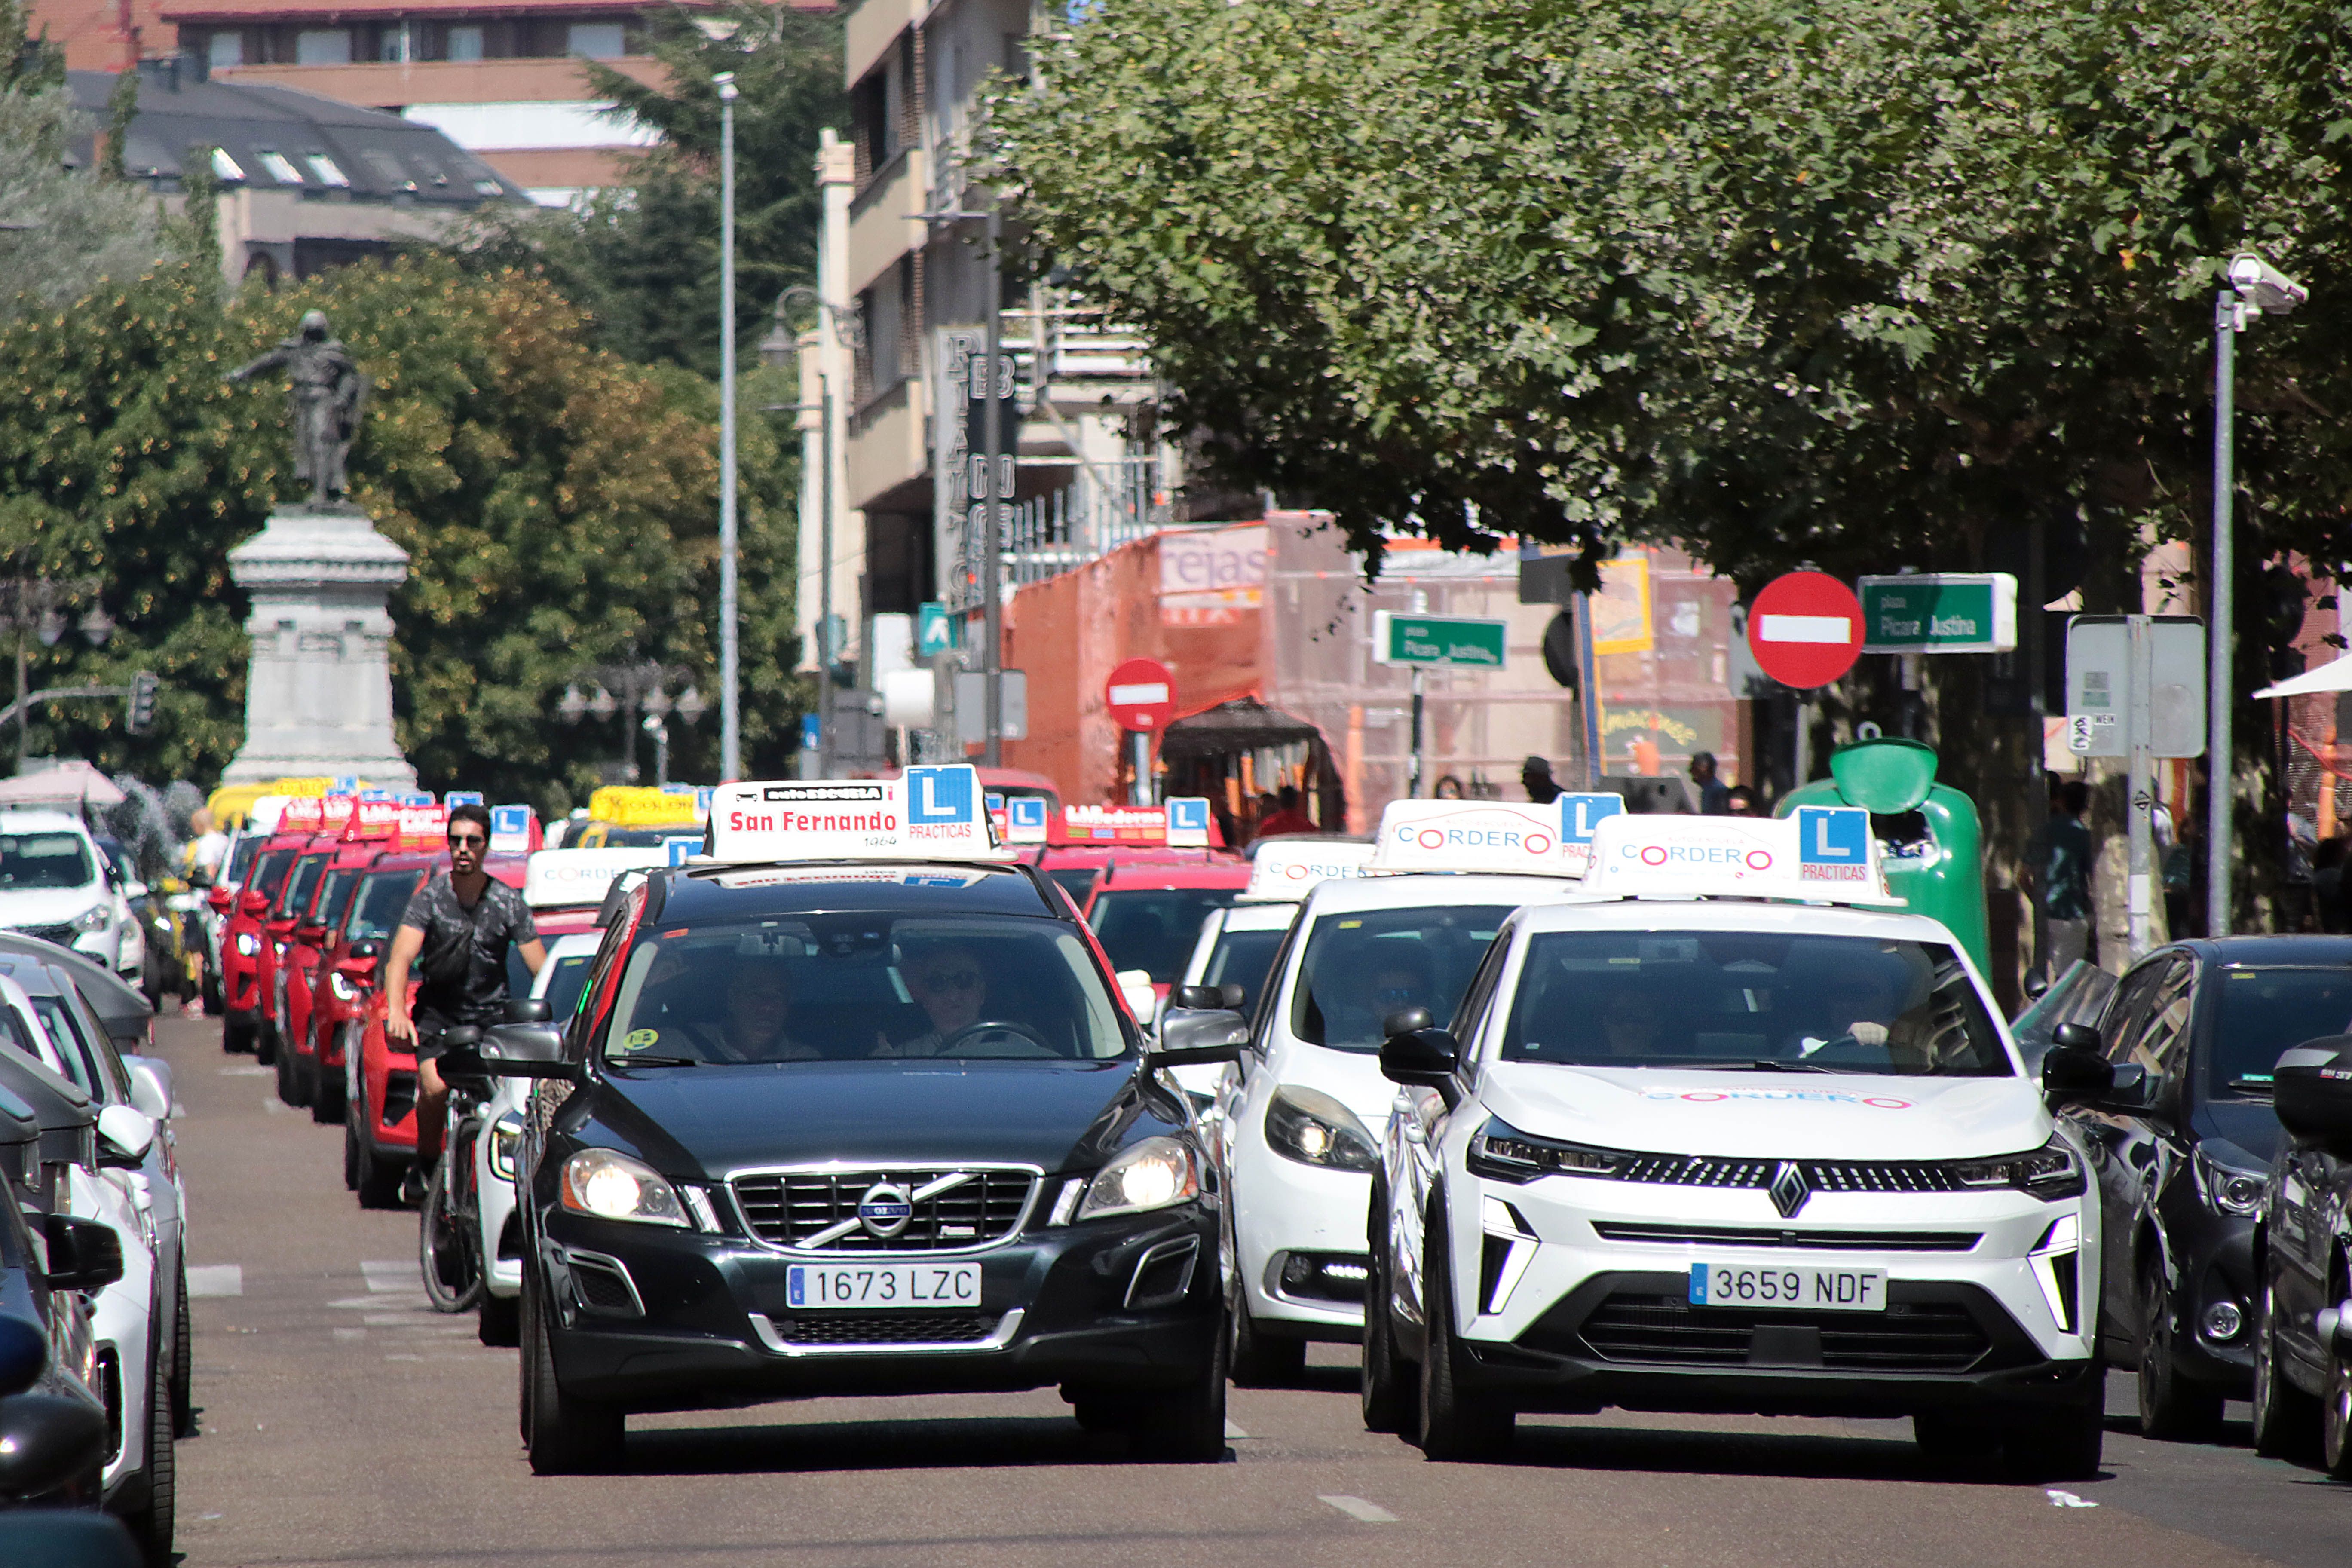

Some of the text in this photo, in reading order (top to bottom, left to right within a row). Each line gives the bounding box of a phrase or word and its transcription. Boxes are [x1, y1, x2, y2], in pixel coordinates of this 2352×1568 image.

[1929, 615, 1977, 636] Justina
[922, 777, 956, 815] L
[501, 811, 519, 832] L
[730, 811, 896, 831] San Fernando
[1017, 804, 1037, 824] L
[1177, 804, 1198, 827] L
[909, 824, 971, 839] PRACTICAS
[1398, 827, 1551, 854] CORDERO
[1817, 818, 1850, 856] L
[1622, 844, 1773, 870] CORDERO
[1803, 864, 1865, 881] PRACTICAS
[1648, 1092, 1912, 1109] CORDERO
[862, 1207, 907, 1216] VOLVO
[817, 1271, 972, 1301] 1673 LZC
[1716, 1270, 1877, 1304] 3659 NDF
